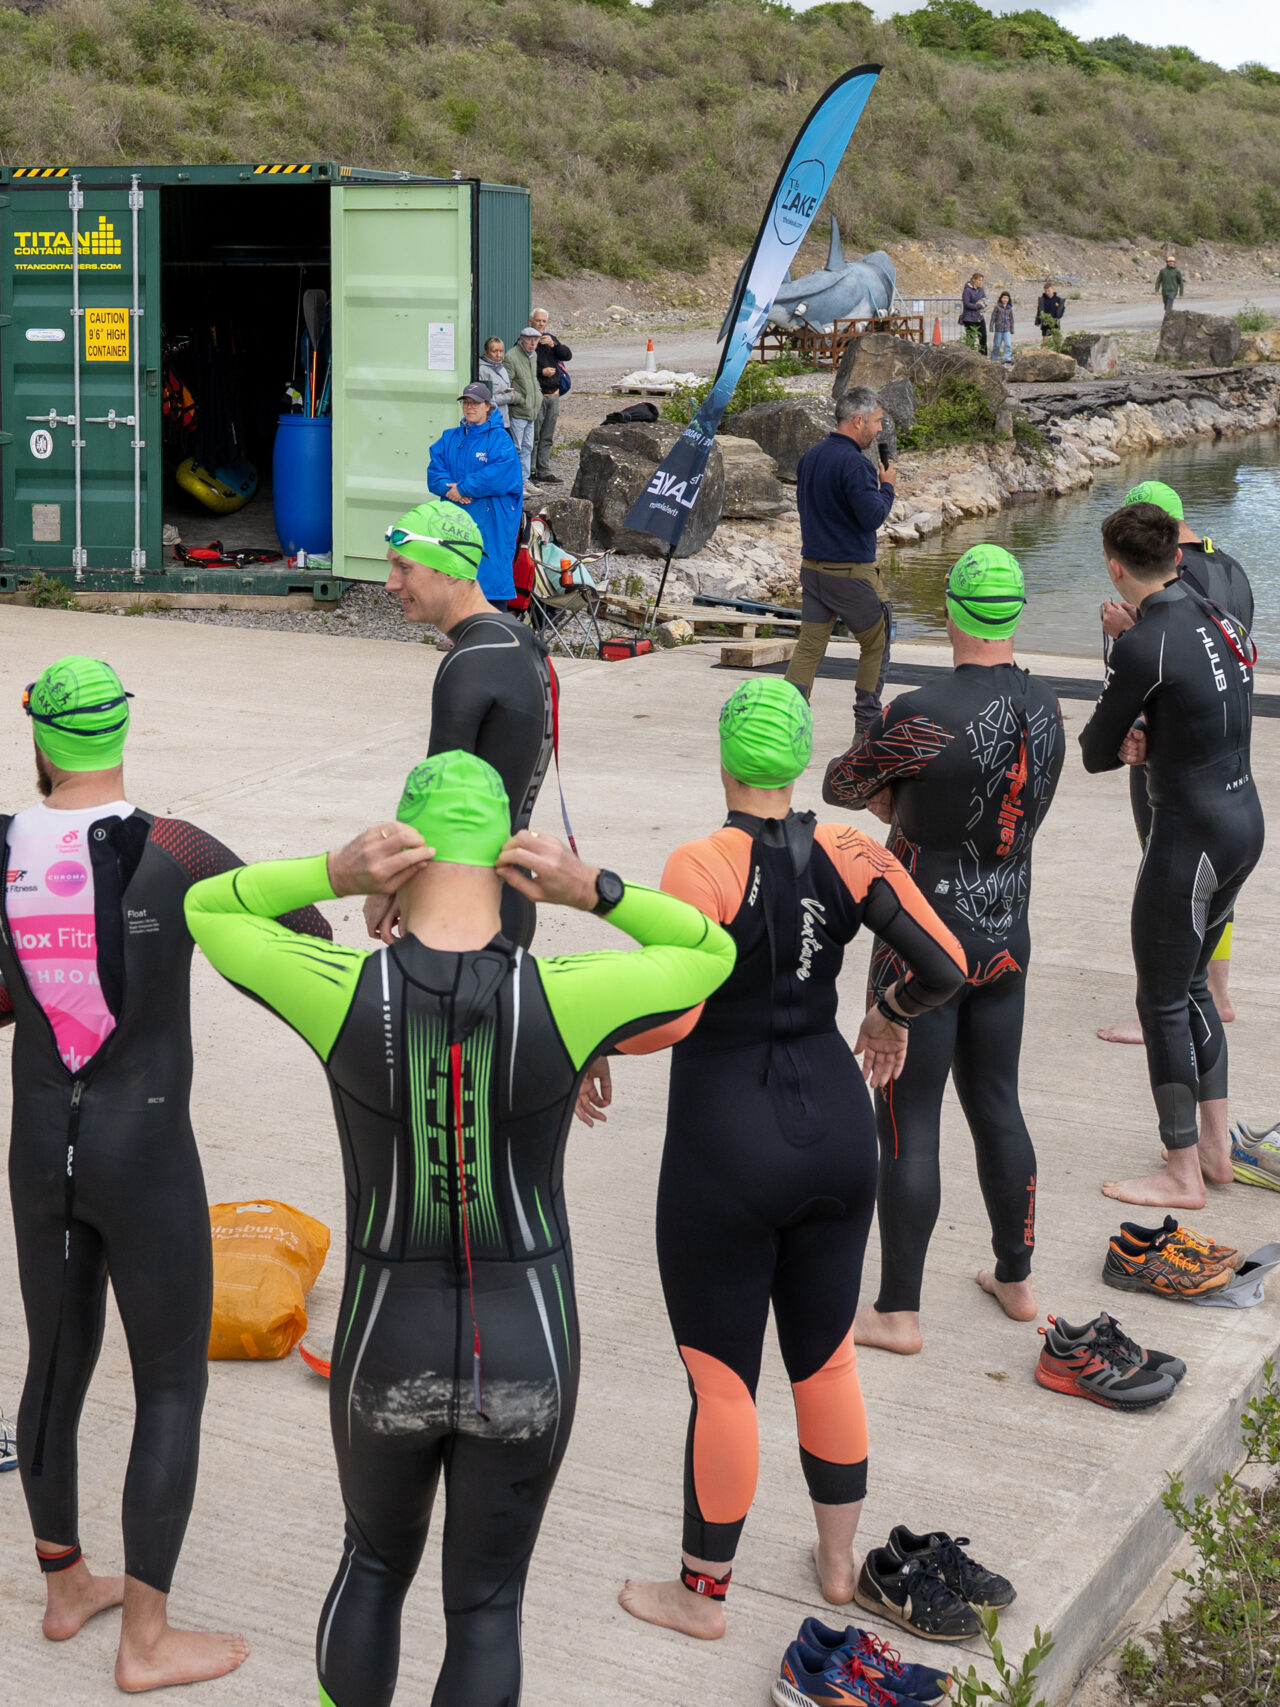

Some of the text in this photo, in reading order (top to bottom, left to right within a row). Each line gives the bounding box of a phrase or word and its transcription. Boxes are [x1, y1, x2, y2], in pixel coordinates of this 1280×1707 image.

[781, 189, 817, 218] LAKE
[14, 231, 91, 247] TITAN
[14, 247, 91, 255] CONTAINERS
[89, 312, 125, 324] CAUTION
[106, 329, 126, 340] HIGH
[87, 345, 127, 357] CONTAINER
[441, 522, 470, 541] LAKE
[1196, 626, 1228, 692] HUUB
[996, 762, 1025, 857] sailfih
[9, 885, 39, 893] Fitness
[127, 909, 147, 919] Float
[801, 897, 827, 982] Venture
[382, 1004, 395, 1065] SURFACE
[1231, 1147, 1259, 1168] HOKA
